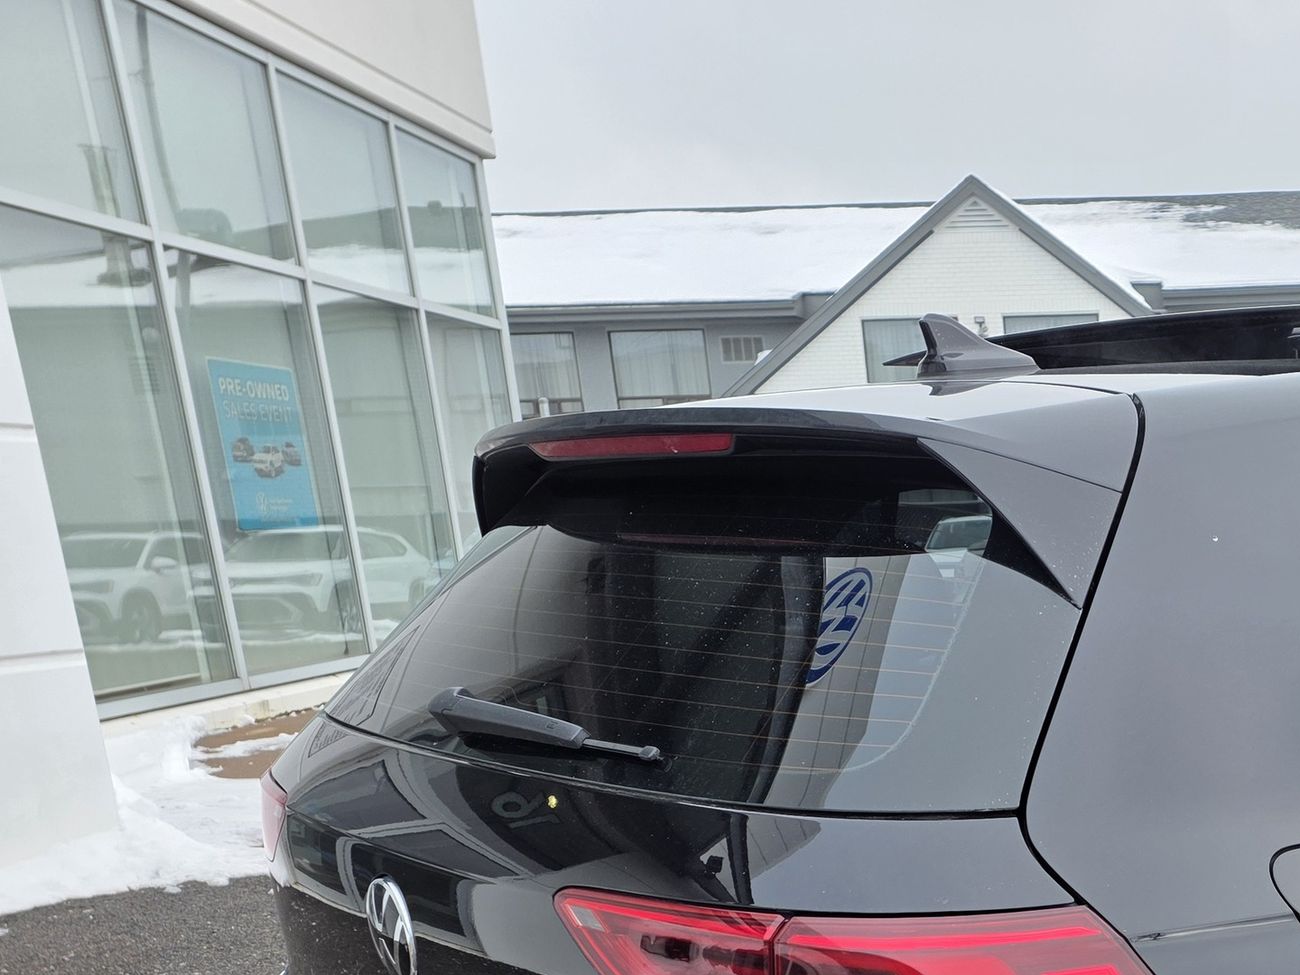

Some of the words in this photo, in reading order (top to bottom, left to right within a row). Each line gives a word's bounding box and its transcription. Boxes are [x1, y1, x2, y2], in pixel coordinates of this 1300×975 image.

[218, 377, 289, 401] PRE-OWNED
[223, 400, 258, 420] SALES
[259, 403, 294, 424] EVENT
